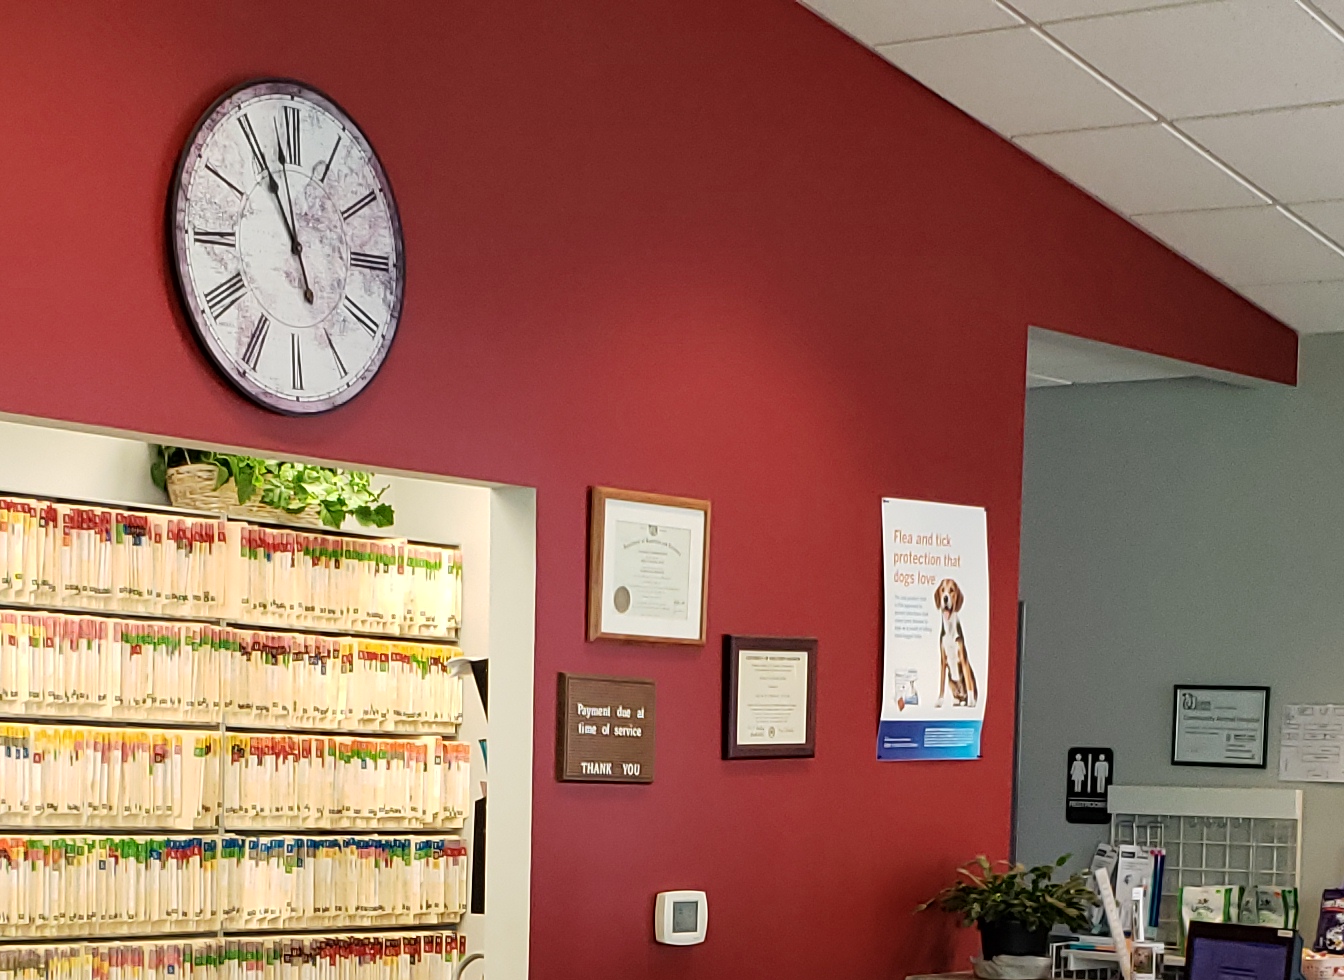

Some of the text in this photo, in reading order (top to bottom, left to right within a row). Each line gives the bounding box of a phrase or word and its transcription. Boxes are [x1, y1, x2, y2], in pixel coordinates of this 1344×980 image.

[893, 529, 952, 547] Flea and tick
[893, 551, 961, 568] protection that
[893, 569, 936, 587] dogs love
[577, 702, 645, 719] Payment due at
[578, 721, 642, 737] time of service
[580, 762, 640, 776] THANK YOU
